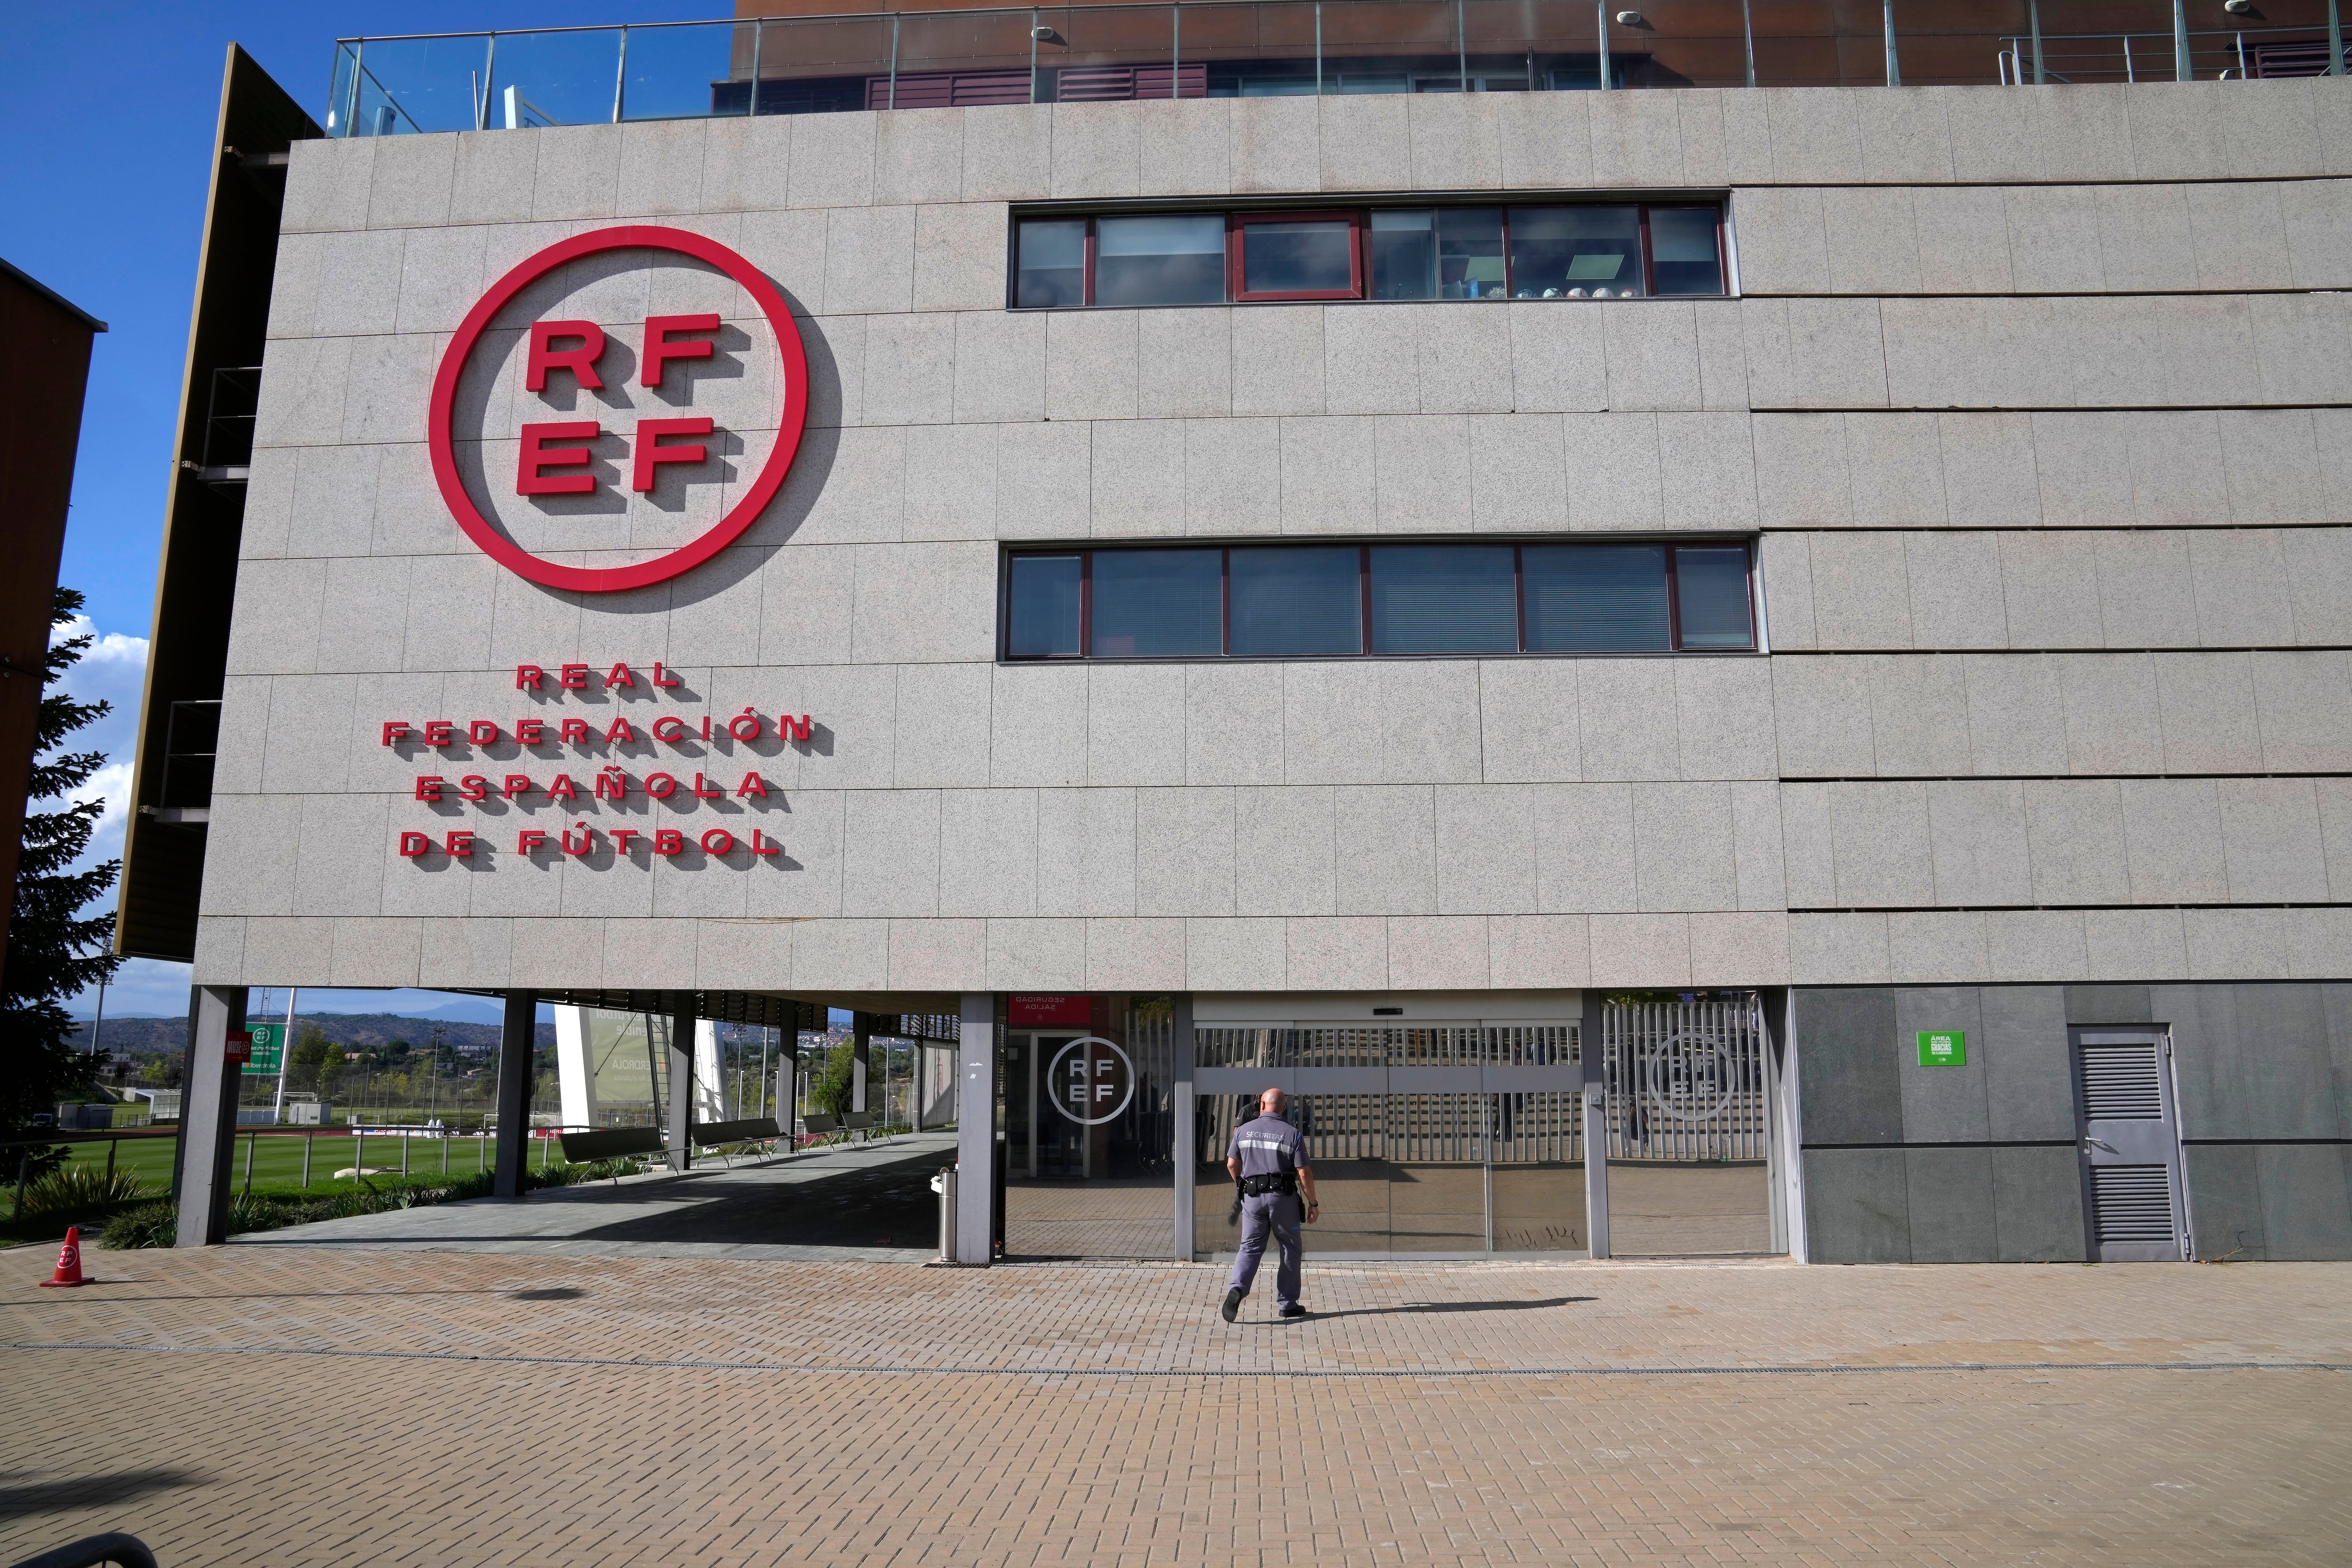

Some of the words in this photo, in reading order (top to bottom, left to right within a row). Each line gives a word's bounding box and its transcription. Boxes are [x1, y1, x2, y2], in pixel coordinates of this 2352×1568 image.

[526, 314, 721, 392] RF
[516, 417, 714, 496] EF
[516, 662, 679, 689] REAL
[382, 707, 810, 746] FEDERACIÓN
[416, 766, 768, 801] ESPAÑOLA
[400, 831, 474, 857] DE
[518, 822, 779, 856] FÚTBOL
[1070, 1059, 1113, 1076] RF
[1070, 1085, 1113, 1101] EF
[1246, 1131, 1285, 1140] SECURITAS
